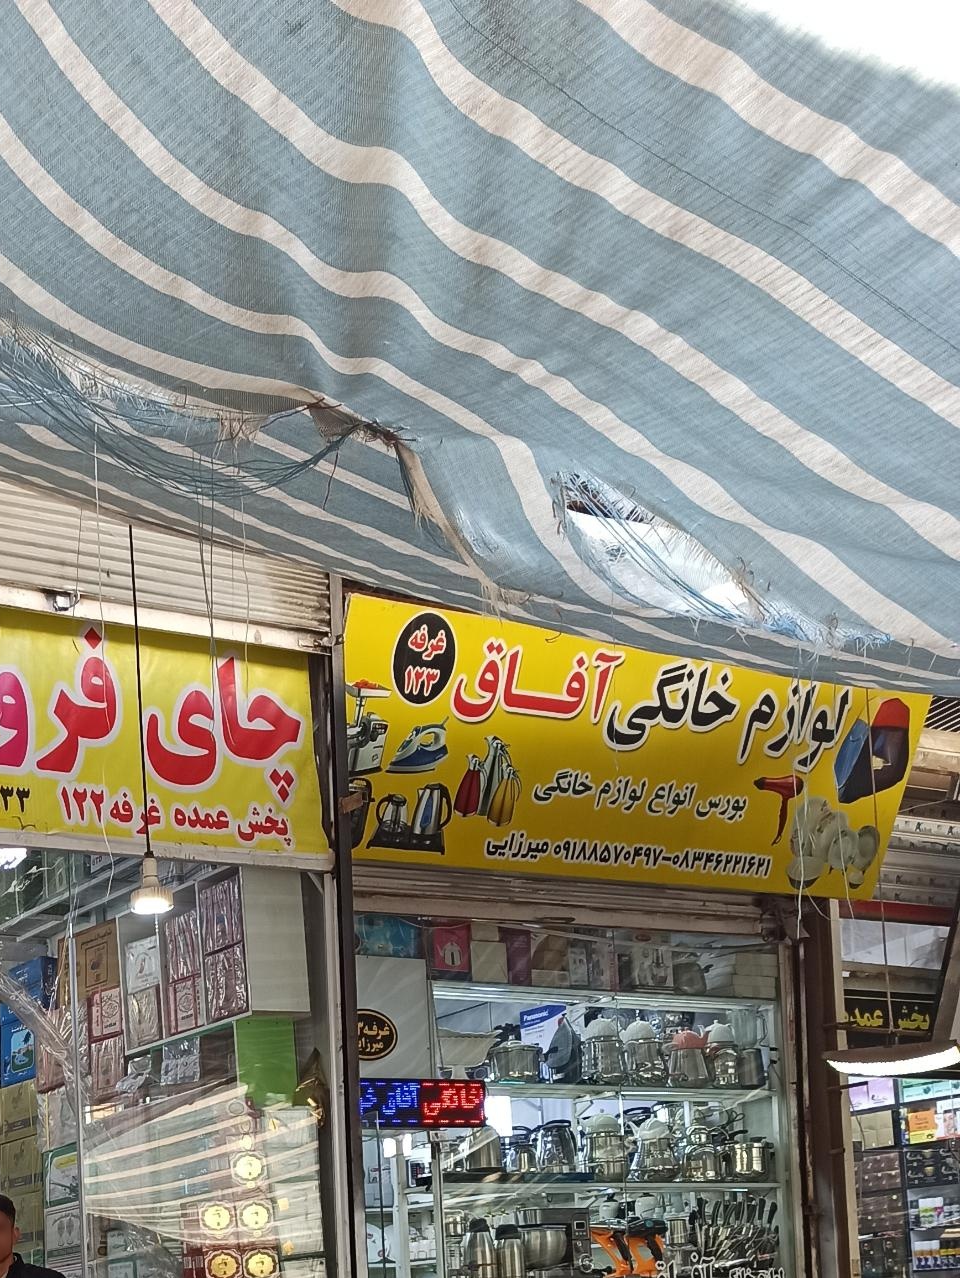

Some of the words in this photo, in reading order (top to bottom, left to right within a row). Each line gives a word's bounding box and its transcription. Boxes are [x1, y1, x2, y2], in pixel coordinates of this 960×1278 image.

[408, 625, 447, 660] غرفه
[404, 665, 440, 696] ۱۲۳
[453, 641, 624, 723] آفاق
[607, 663, 737, 745] خانگی
[146, 656, 302, 802] چای
[738, 685, 850, 768] لوازم
[534, 769, 592, 801] خانگی
[596, 779, 646, 811] لوازم
[648, 782, 695, 815] انواع
[61, 785, 106, 825] ۱۲۲
[173, 806, 230, 830] عمده
[696, 796, 747, 821] بورس
[238, 806, 290, 846] پخش
[486, 833, 549, 860] میرزایی
